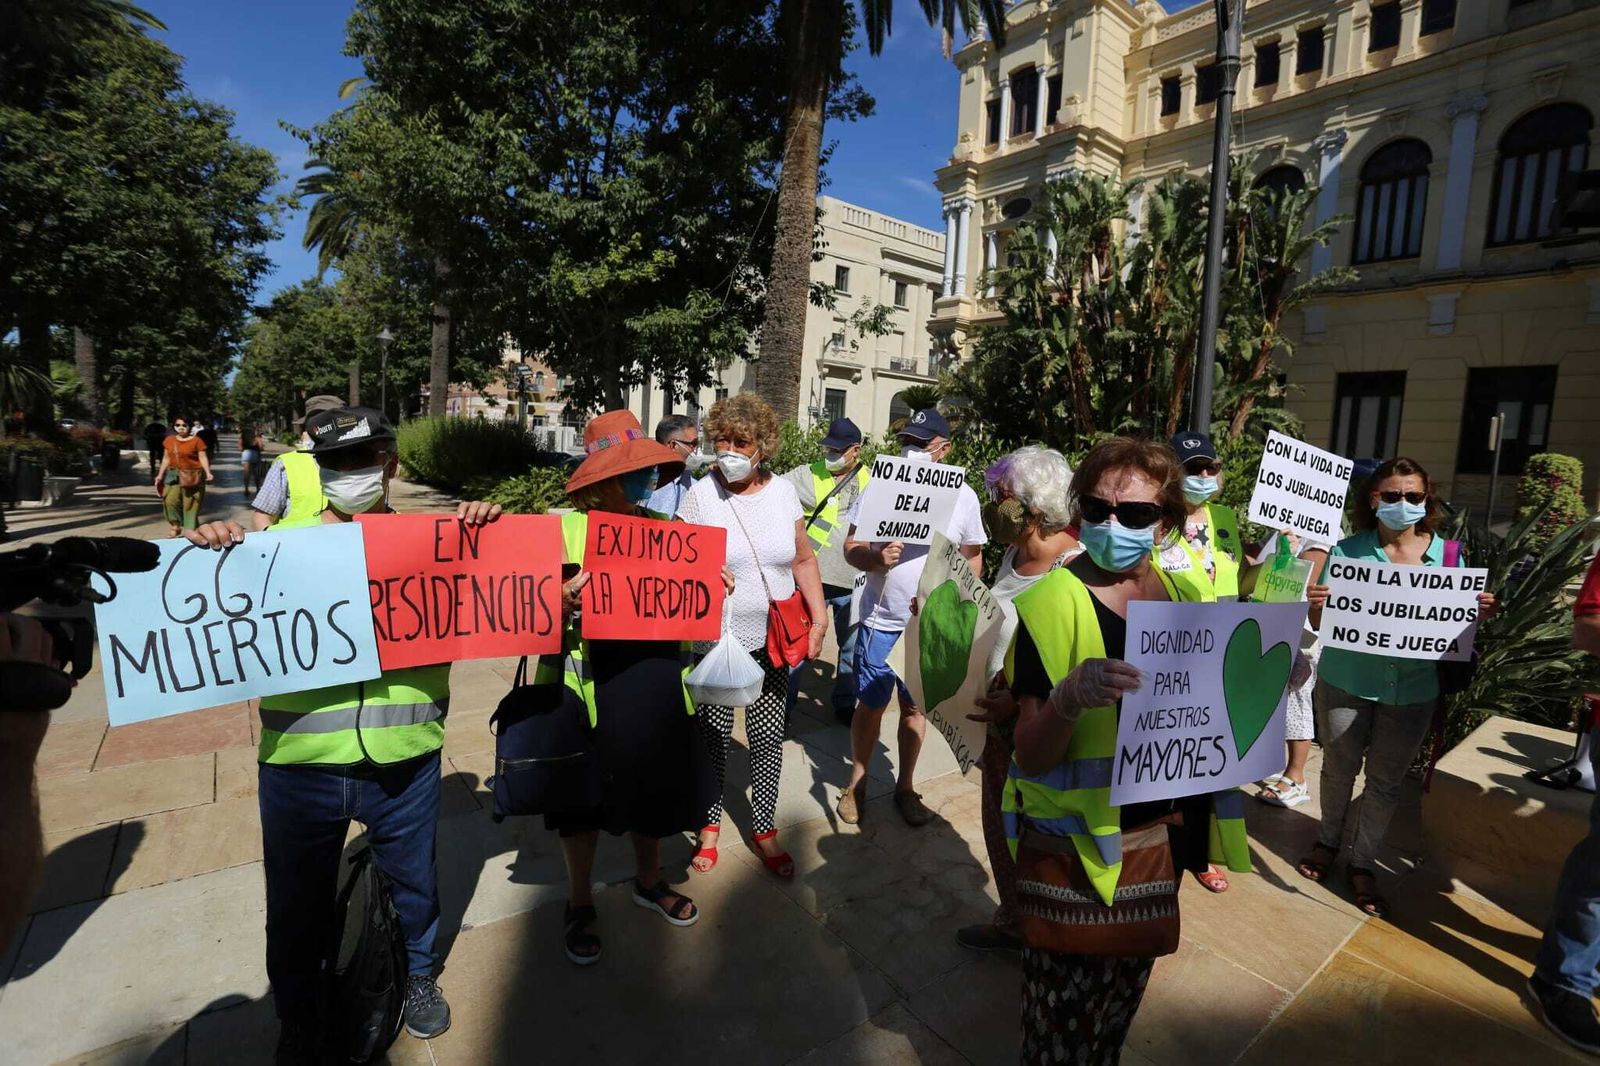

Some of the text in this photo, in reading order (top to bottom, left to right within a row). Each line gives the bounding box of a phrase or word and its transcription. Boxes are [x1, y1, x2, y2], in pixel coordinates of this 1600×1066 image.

[872, 460, 963, 489] NO AL SAQUEO
[1265, 438, 1351, 481] CON LA VIDA DE
[894, 494, 930, 513] DE LA
[1258, 469, 1344, 509] LOS JUBILADOS
[876, 521, 930, 540] SANIDAD
[1259, 502, 1330, 536] NO SE JUEGA
[434, 517, 479, 562] EN
[597, 523, 698, 565] EXIJMOS
[854, 575, 866, 589] NO
[945, 543, 997, 620] RESIDENCIAS
[1330, 563, 1485, 591] CON LA VIDA DE
[368, 571, 553, 642] RESIDENCIAS
[588, 571, 711, 620] LA VERDAD
[1326, 594, 1477, 622] LOS JUBILADOS
[108, 599, 357, 698] MUERTOS
[1140, 629, 1214, 655] DIGNIDAD
[1332, 626, 1460, 654] NO SE JUEGA
[1154, 670, 1190, 696] PARA
[1134, 706, 1210, 732] NUESTROS
[1118, 735, 1226, 786] MAYORES
